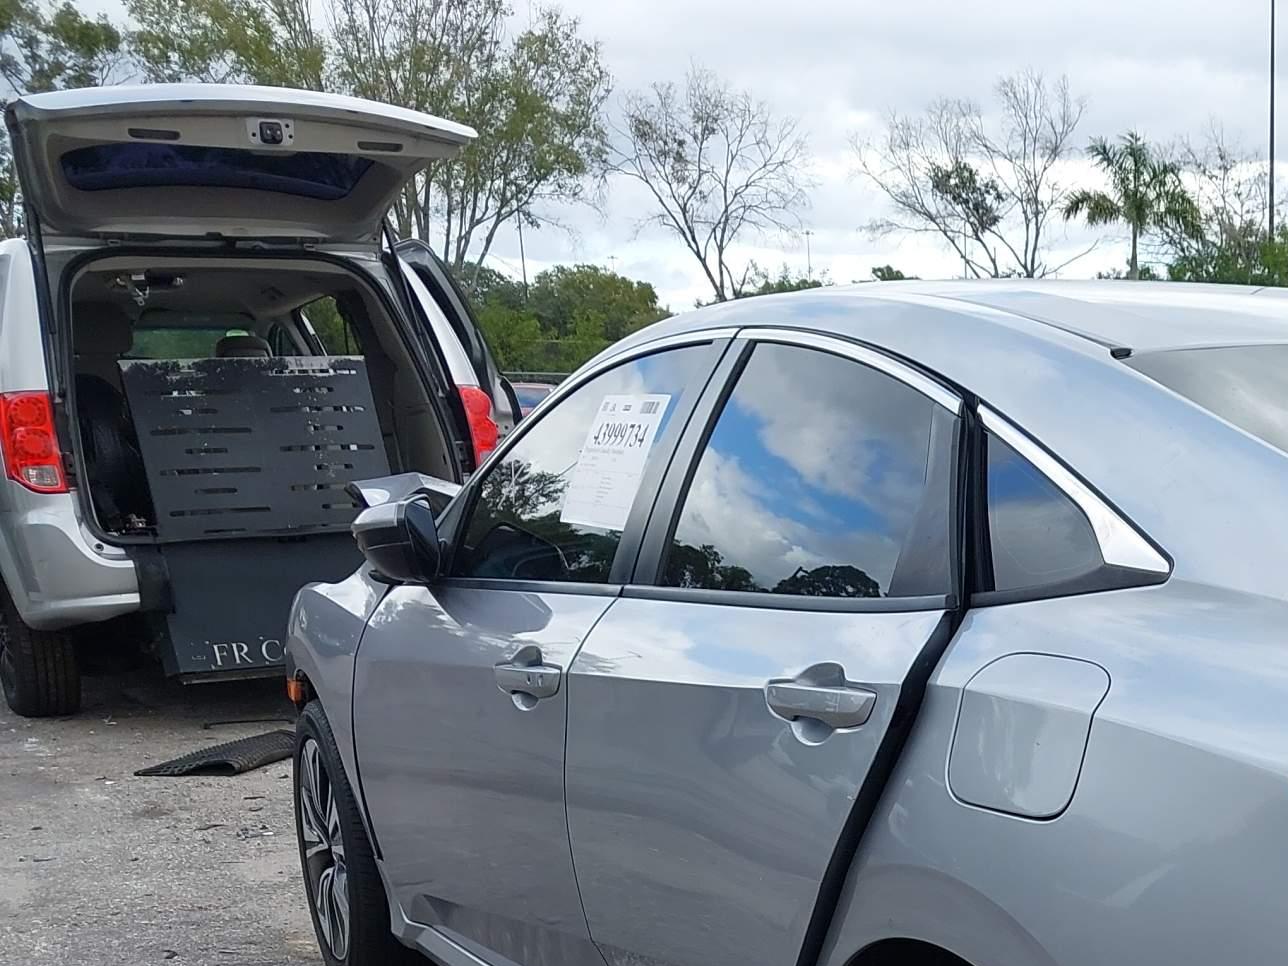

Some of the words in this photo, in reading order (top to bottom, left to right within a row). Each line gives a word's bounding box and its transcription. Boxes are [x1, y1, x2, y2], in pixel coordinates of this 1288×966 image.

[593, 423, 650, 448] 43999734
[211, 642, 253, 666] FR
[261, 639, 287, 662] C
